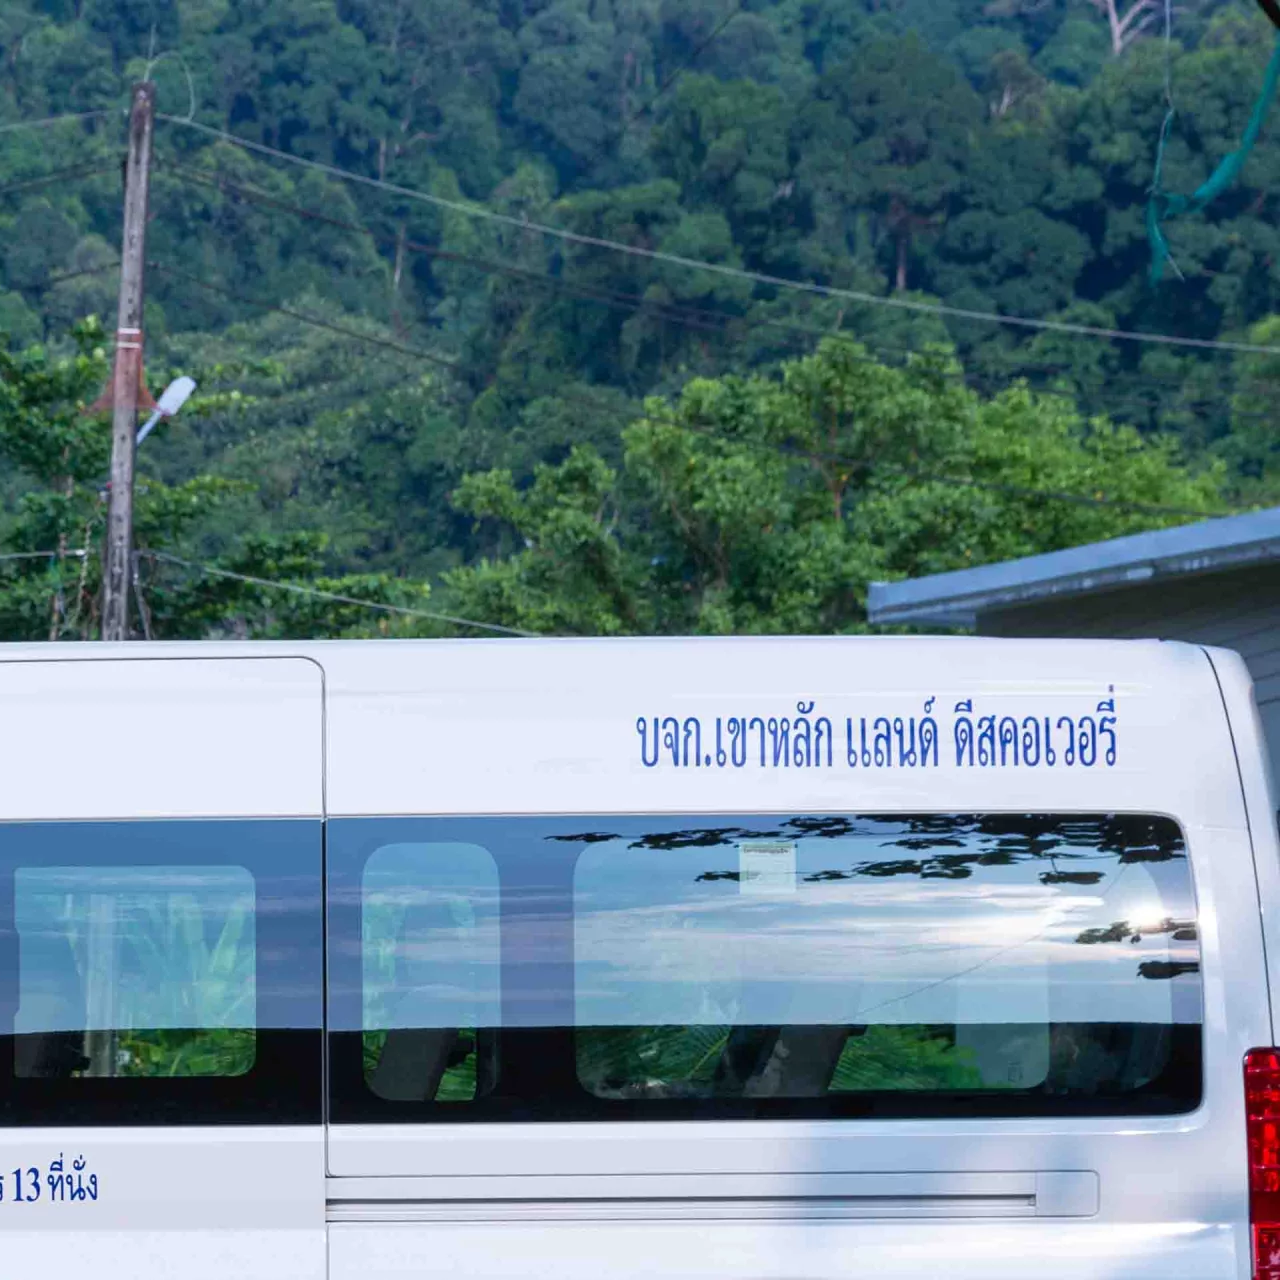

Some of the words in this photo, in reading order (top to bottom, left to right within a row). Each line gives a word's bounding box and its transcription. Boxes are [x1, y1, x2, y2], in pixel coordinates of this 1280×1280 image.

[636, 701, 833, 768] บจก.เขาหลัก
[846, 696, 939, 768] แลนด์
[953, 684, 1118, 768] ดีสคอเวอรี่
[11, 1167, 41, 1203] 13
[46, 1152, 98, 1202] ที่นั่ง
